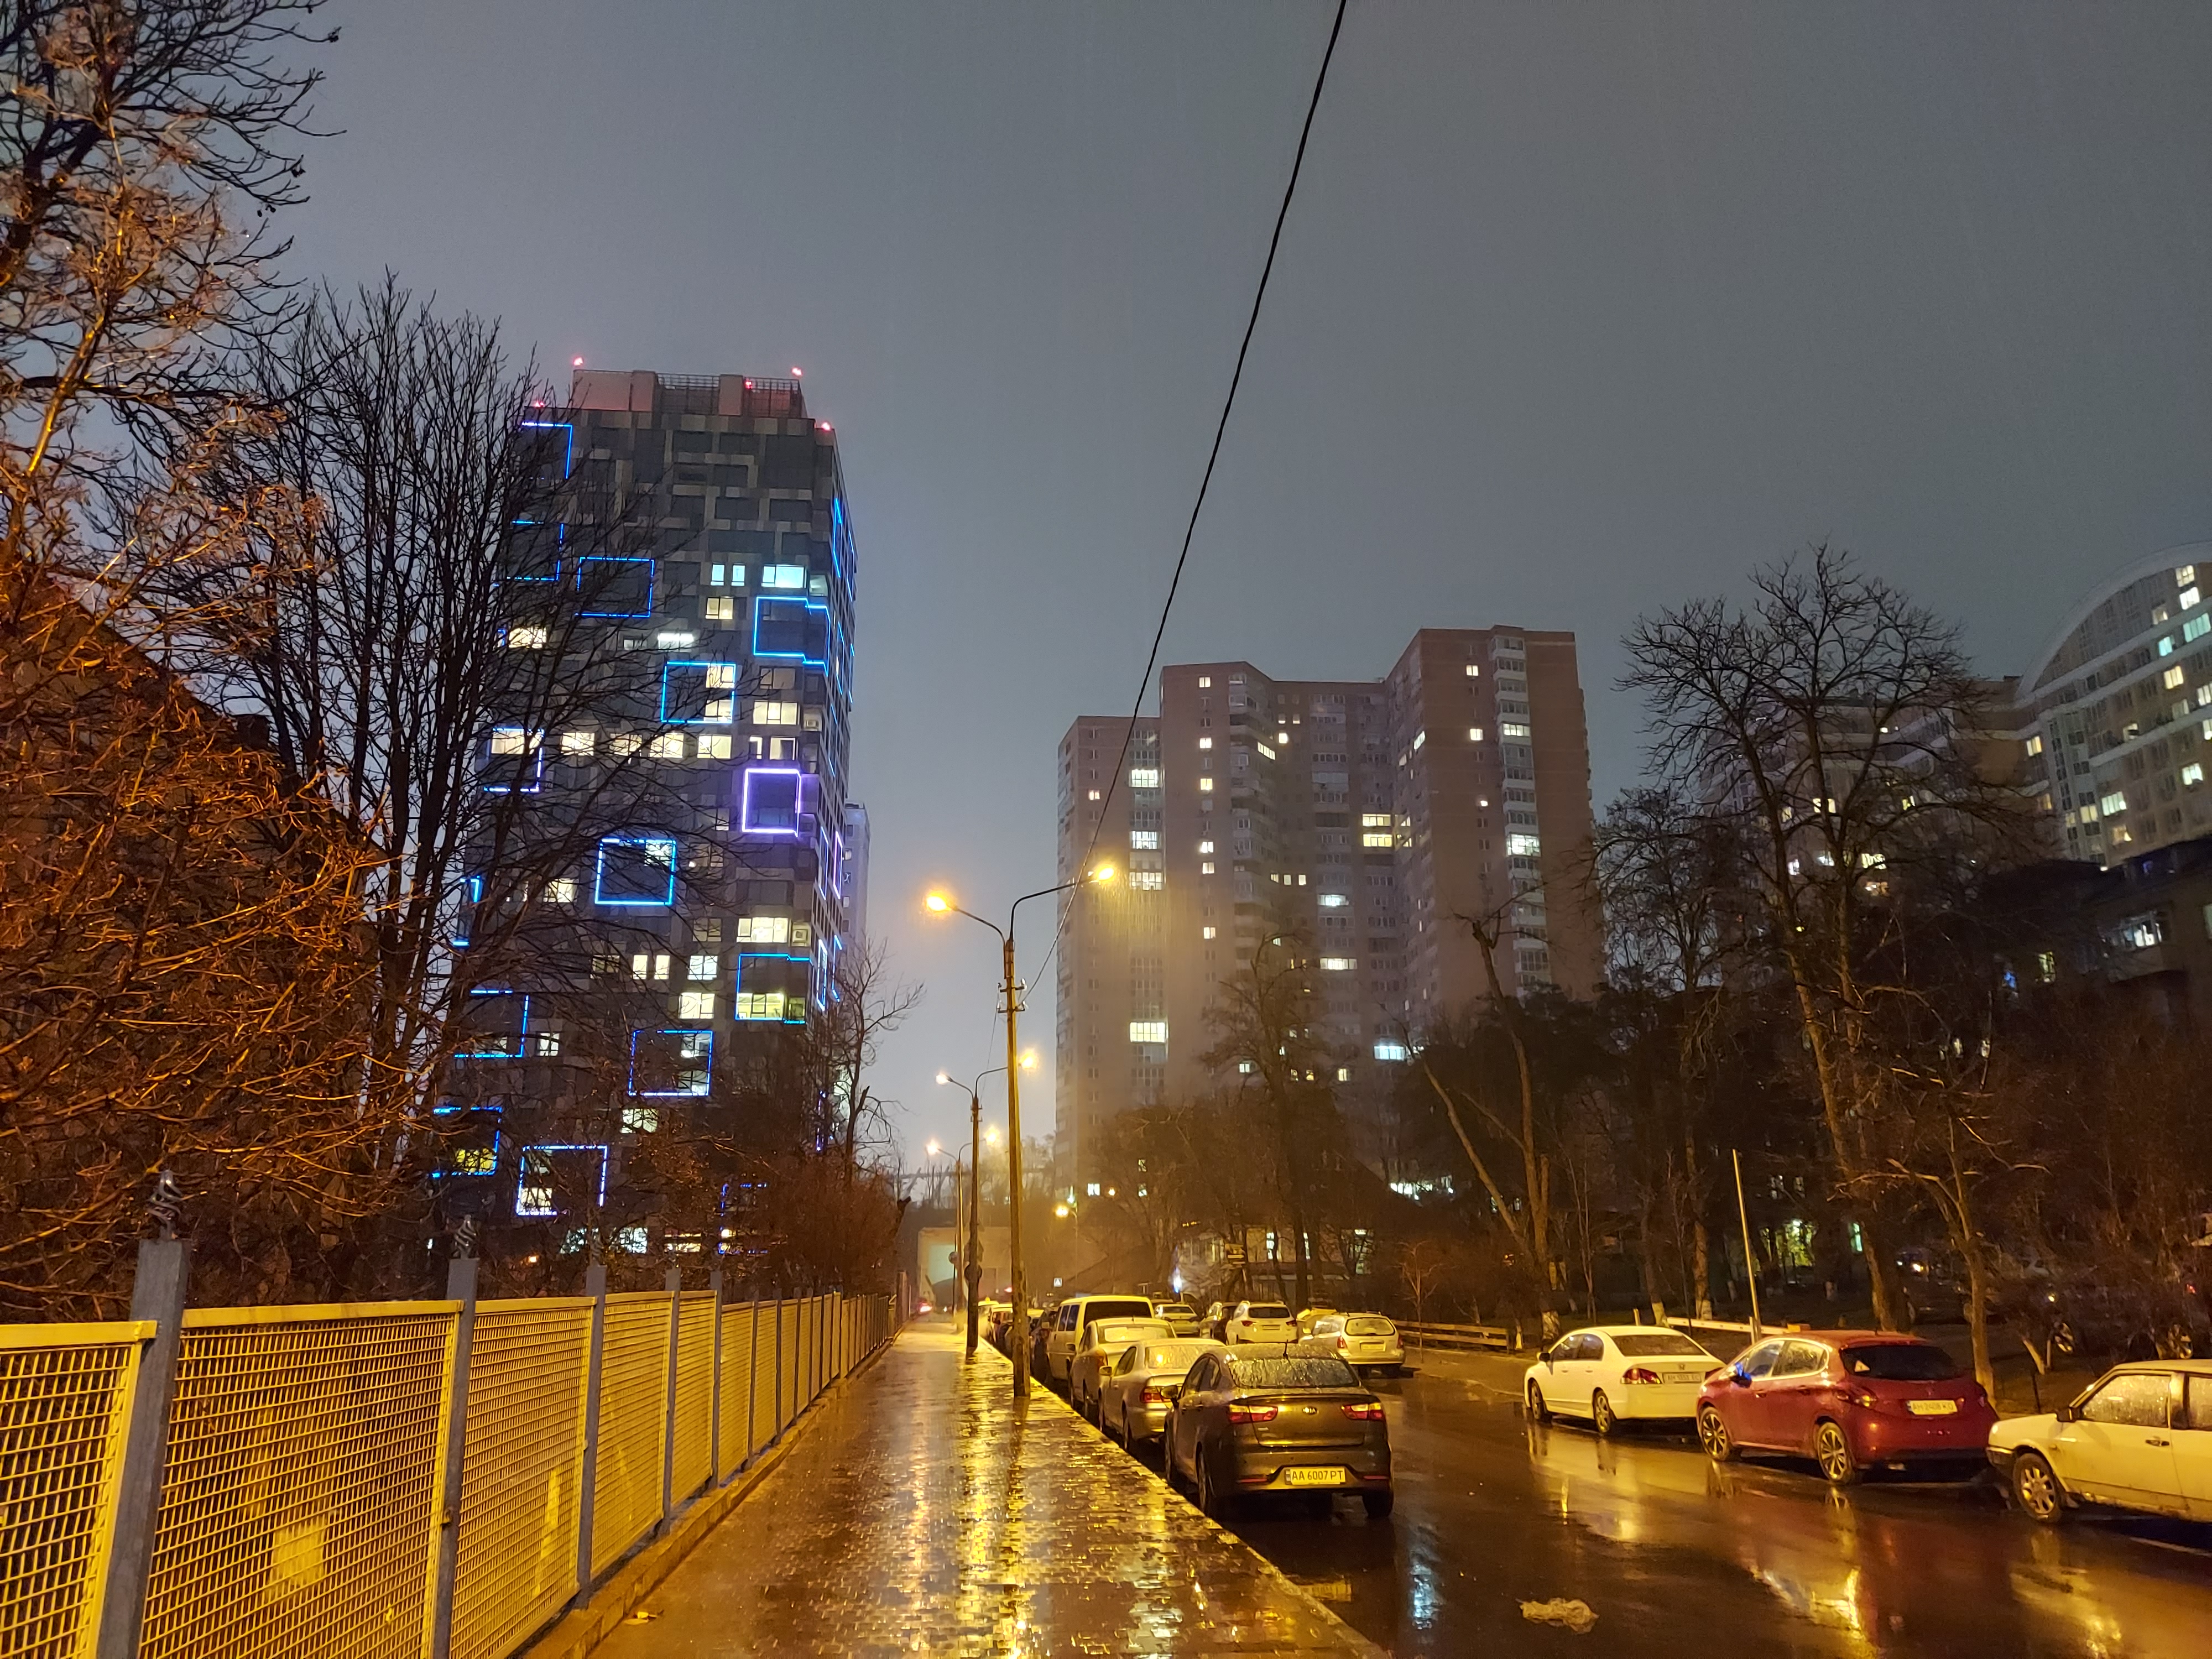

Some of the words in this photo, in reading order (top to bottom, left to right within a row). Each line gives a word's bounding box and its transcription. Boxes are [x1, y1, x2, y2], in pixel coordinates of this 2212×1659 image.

[1292, 1470, 1305, 1480] AA
[1307, 1470, 1328, 1480] 6007
[1330, 1470, 1343, 1480] PT
